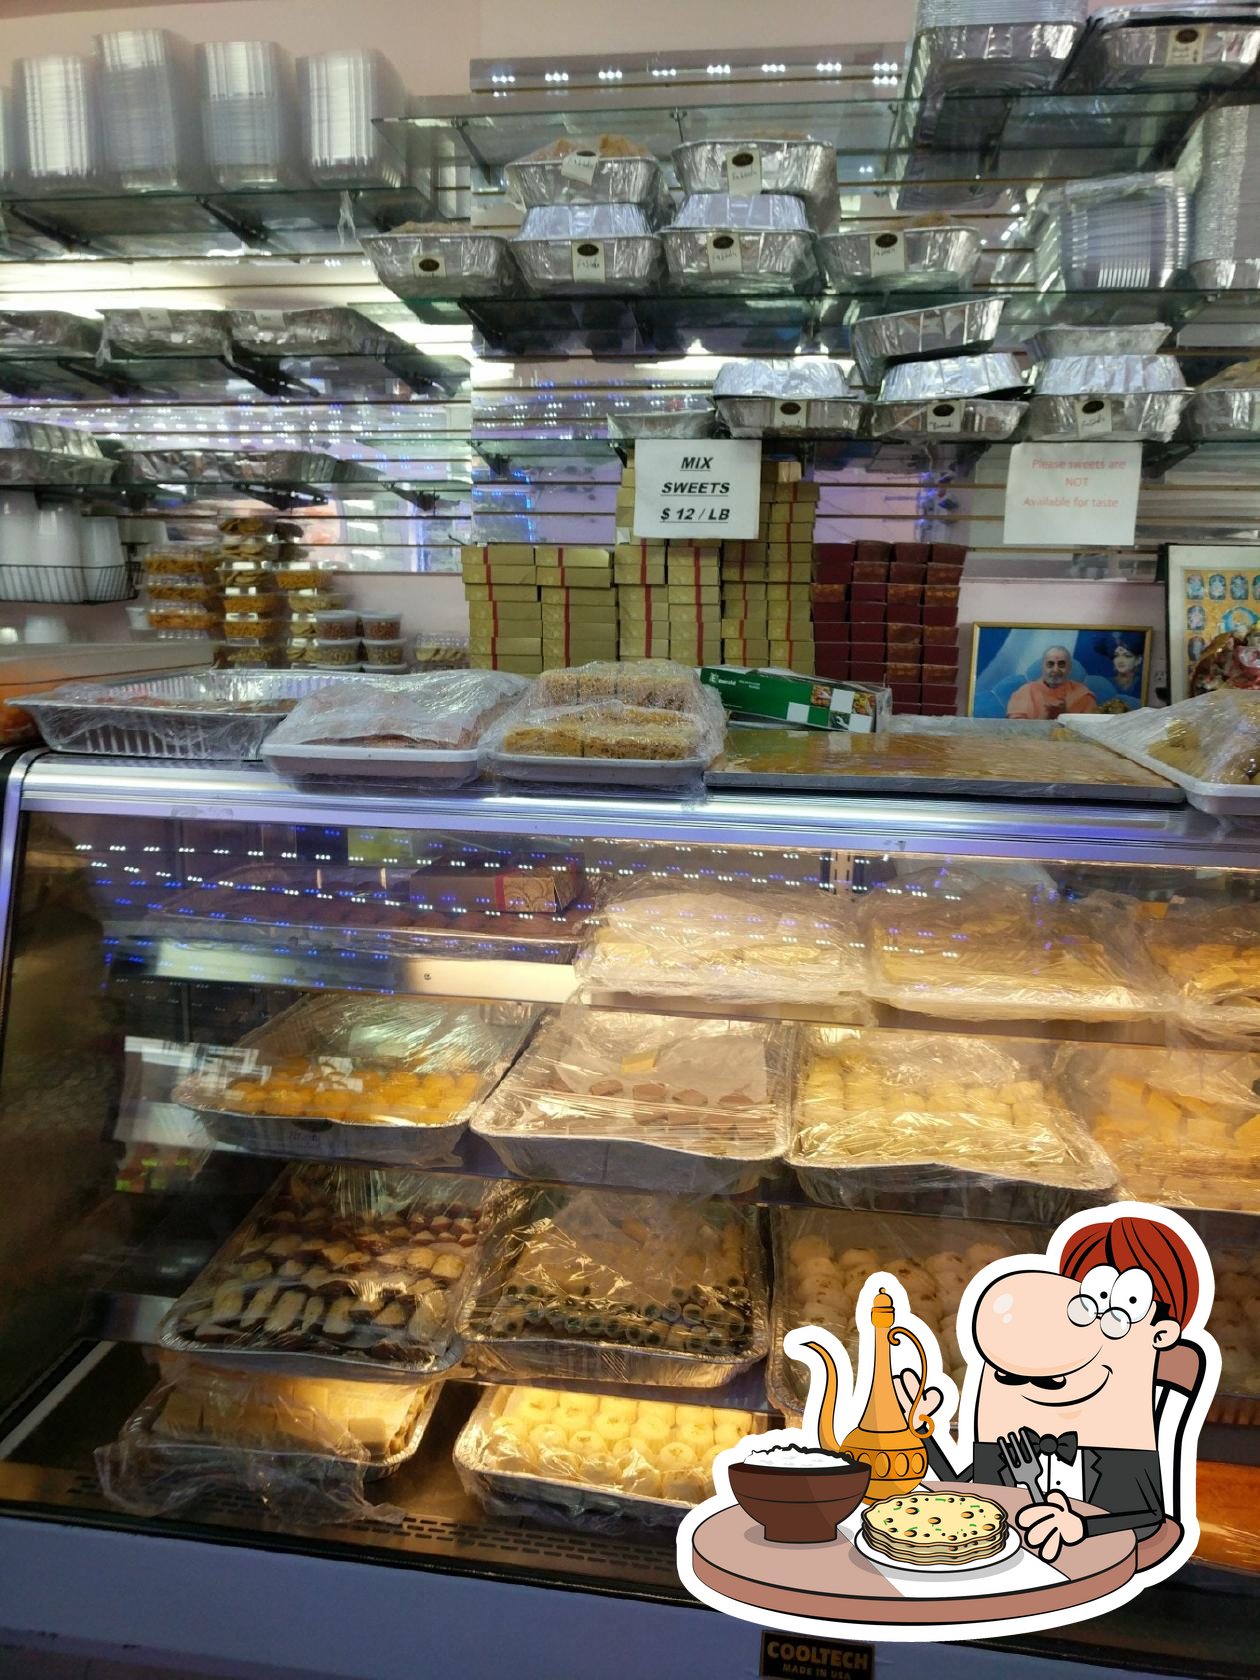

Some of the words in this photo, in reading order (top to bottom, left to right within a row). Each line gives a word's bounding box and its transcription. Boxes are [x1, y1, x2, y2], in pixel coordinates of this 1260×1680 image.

[680, 456, 714, 470] MIX
[1032, 458, 1066, 470] Please
[1068, 459, 1105, 470] sweets
[1108, 461, 1127, 470] are
[661, 481, 731, 494] SWEETS
[1065, 477, 1088, 487] NOT
[1023, 496, 1071, 507] Available
[1072, 496, 1089, 509] for
[1092, 497, 1119, 507] taste
[766, 1640, 869, 1670] COOLTECH
[782, 1663, 813, 1677] MADE
[815, 1667, 828, 1677] IN
